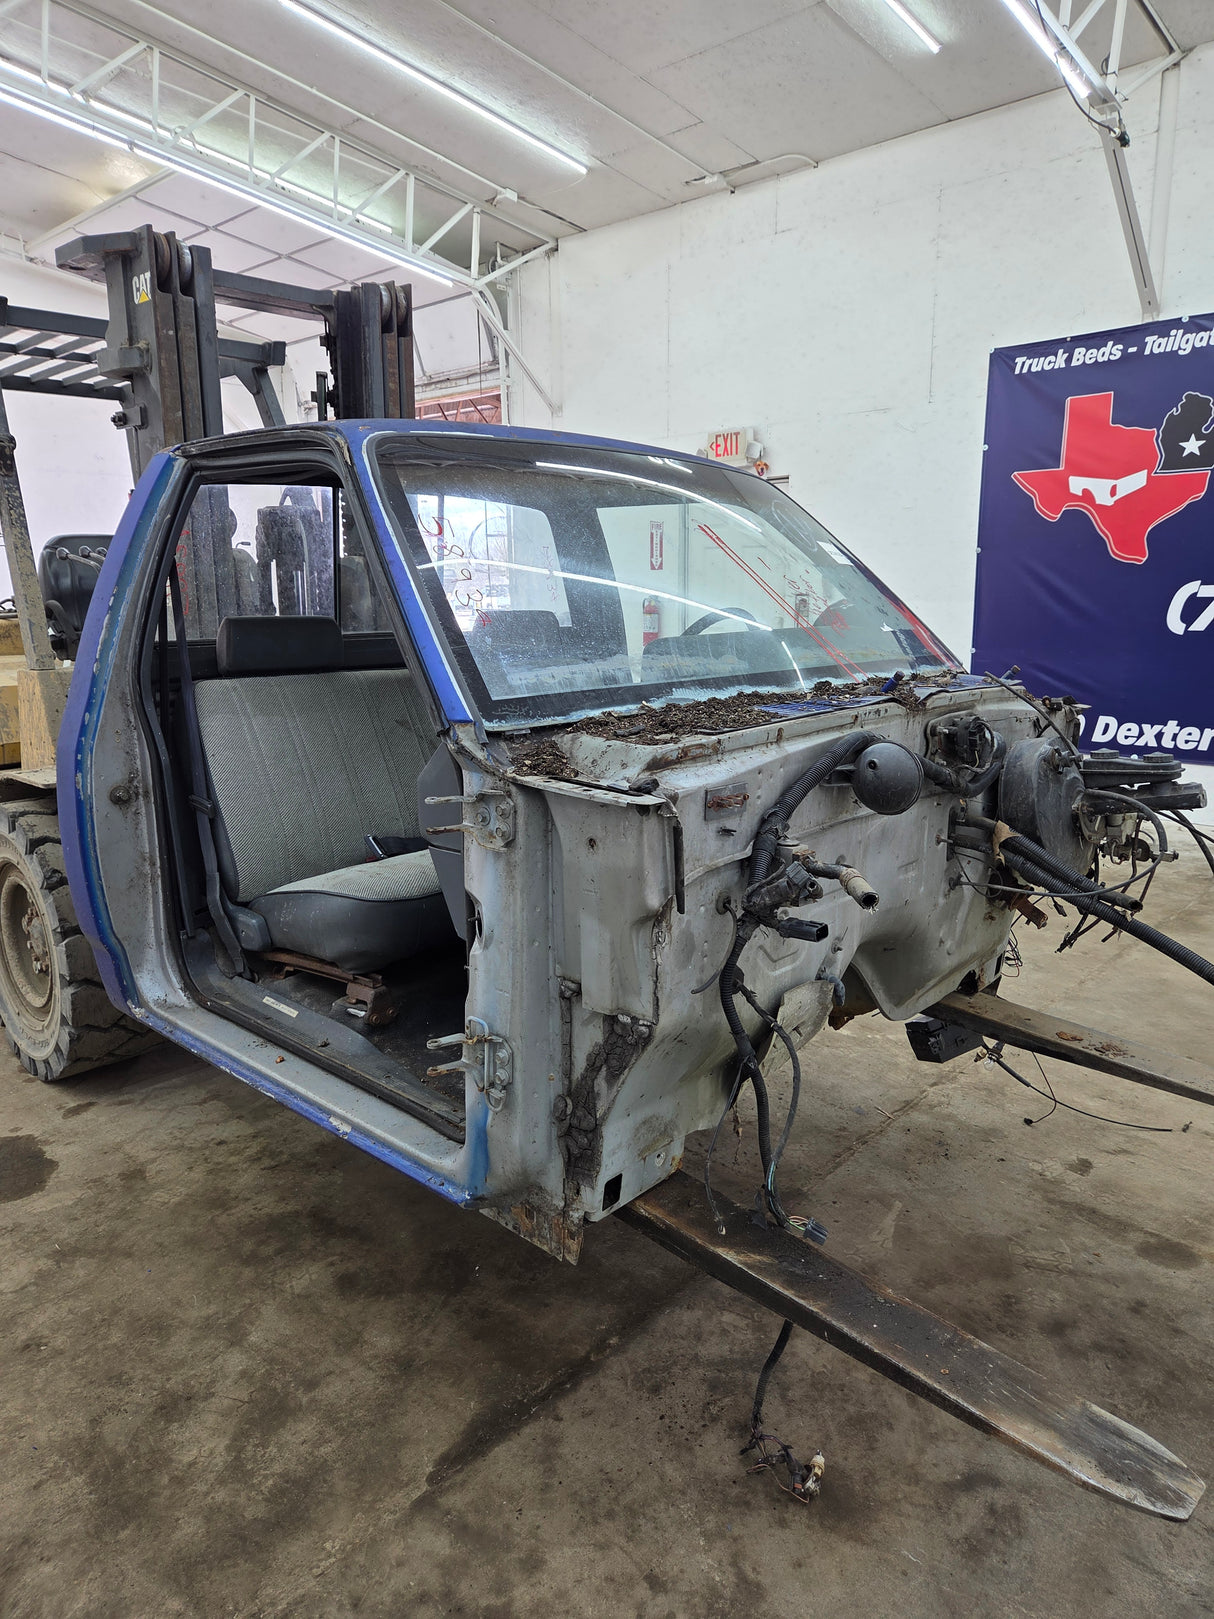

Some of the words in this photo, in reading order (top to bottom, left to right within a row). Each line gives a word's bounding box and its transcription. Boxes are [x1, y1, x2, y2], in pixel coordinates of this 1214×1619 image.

[132, 271, 151, 305] CAT
[1014, 349, 1069, 375] Truck
[1071, 341, 1124, 367] Beds
[715, 432, 740, 458] EXIT
[1091, 715, 1214, 752] Dexter
